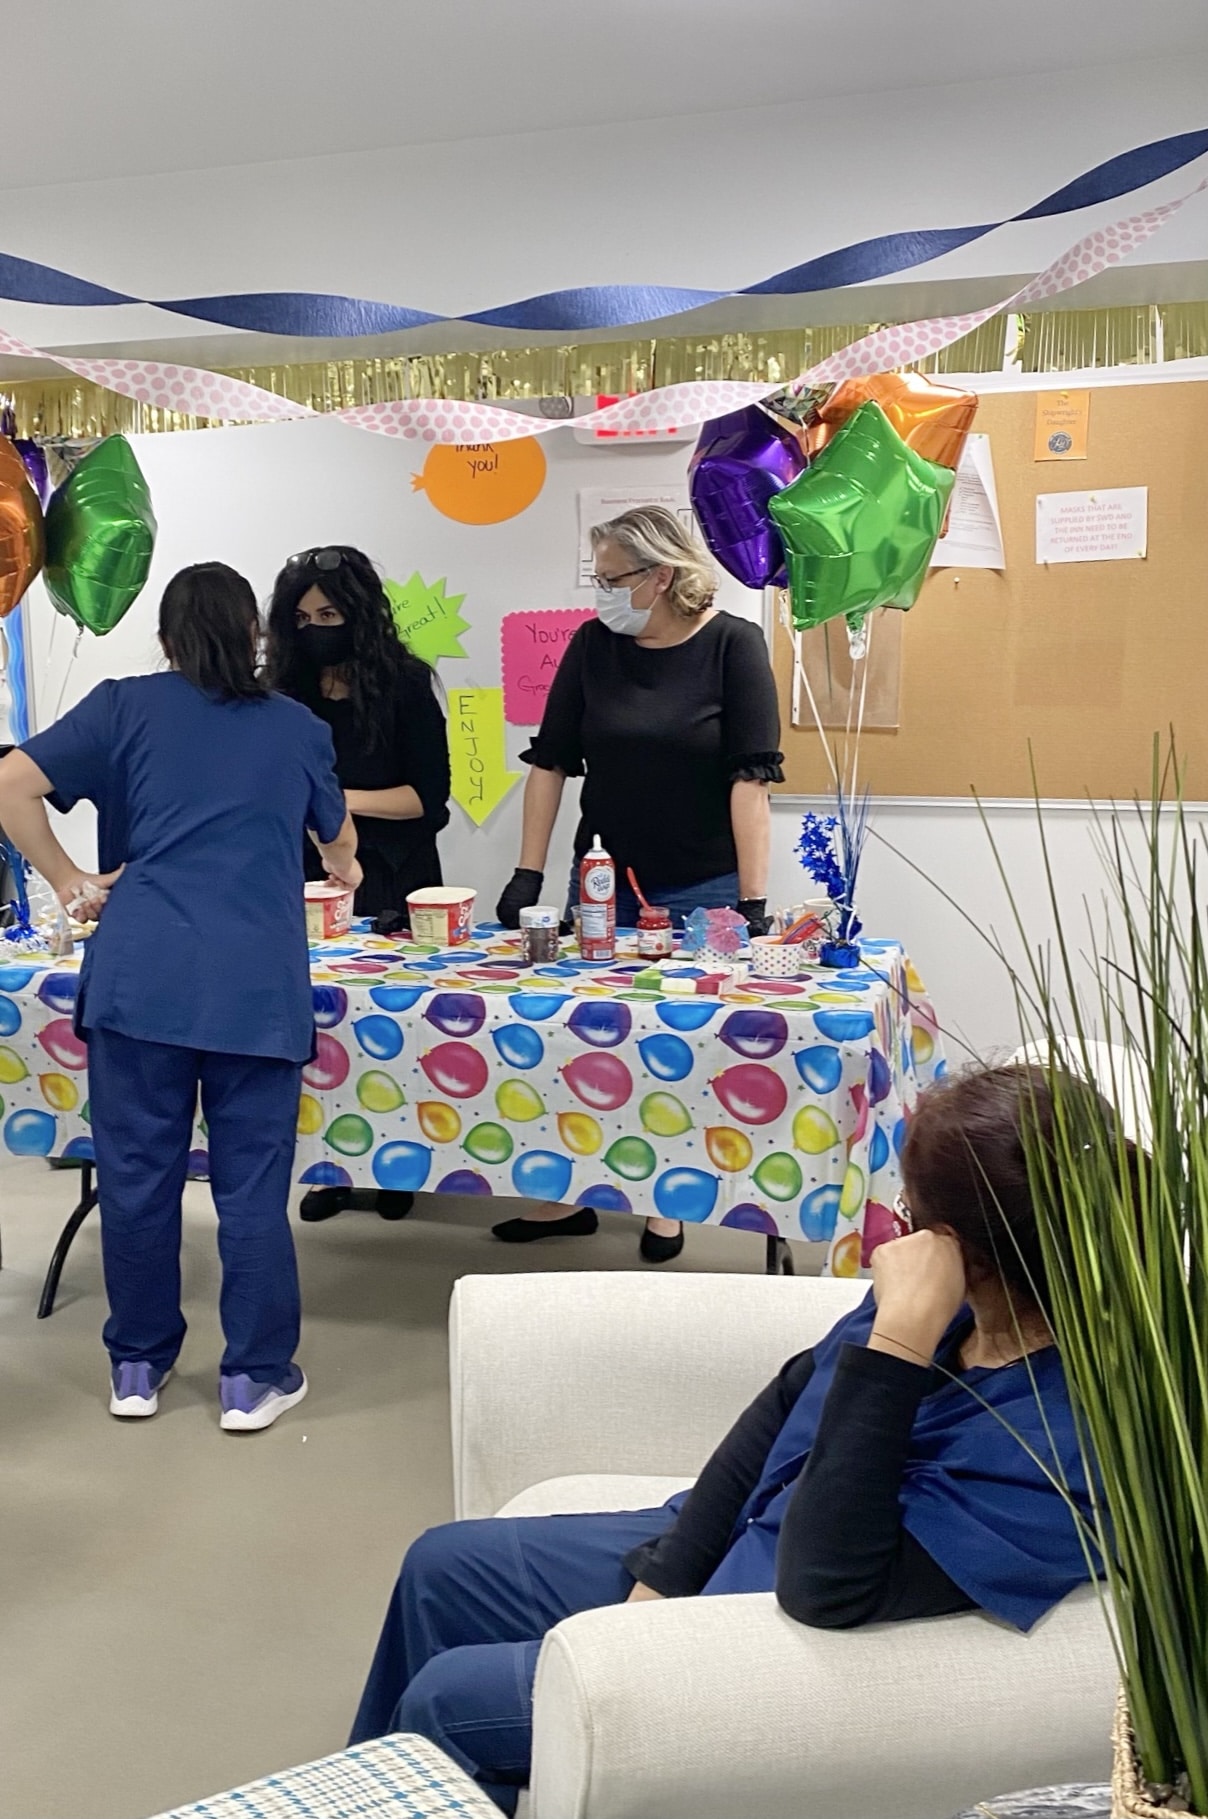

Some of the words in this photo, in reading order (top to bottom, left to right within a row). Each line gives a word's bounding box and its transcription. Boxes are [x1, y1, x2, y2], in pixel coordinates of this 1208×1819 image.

[467, 453, 498, 479] you!
[1060, 505, 1085, 513] MASKS
[1088, 504, 1106, 512] THAT
[1107, 503, 1122, 511] ARE
[1050, 516, 1084, 524] SUPPLIED
[1085, 524, 1105, 532] NEED
[1118, 522, 1128, 530] BE
[1050, 536, 1088, 544] RETURNED
[1101, 533, 1115, 541] THE
[1064, 545, 1074, 553] OF
[459, 695, 485, 805] ENJOY
